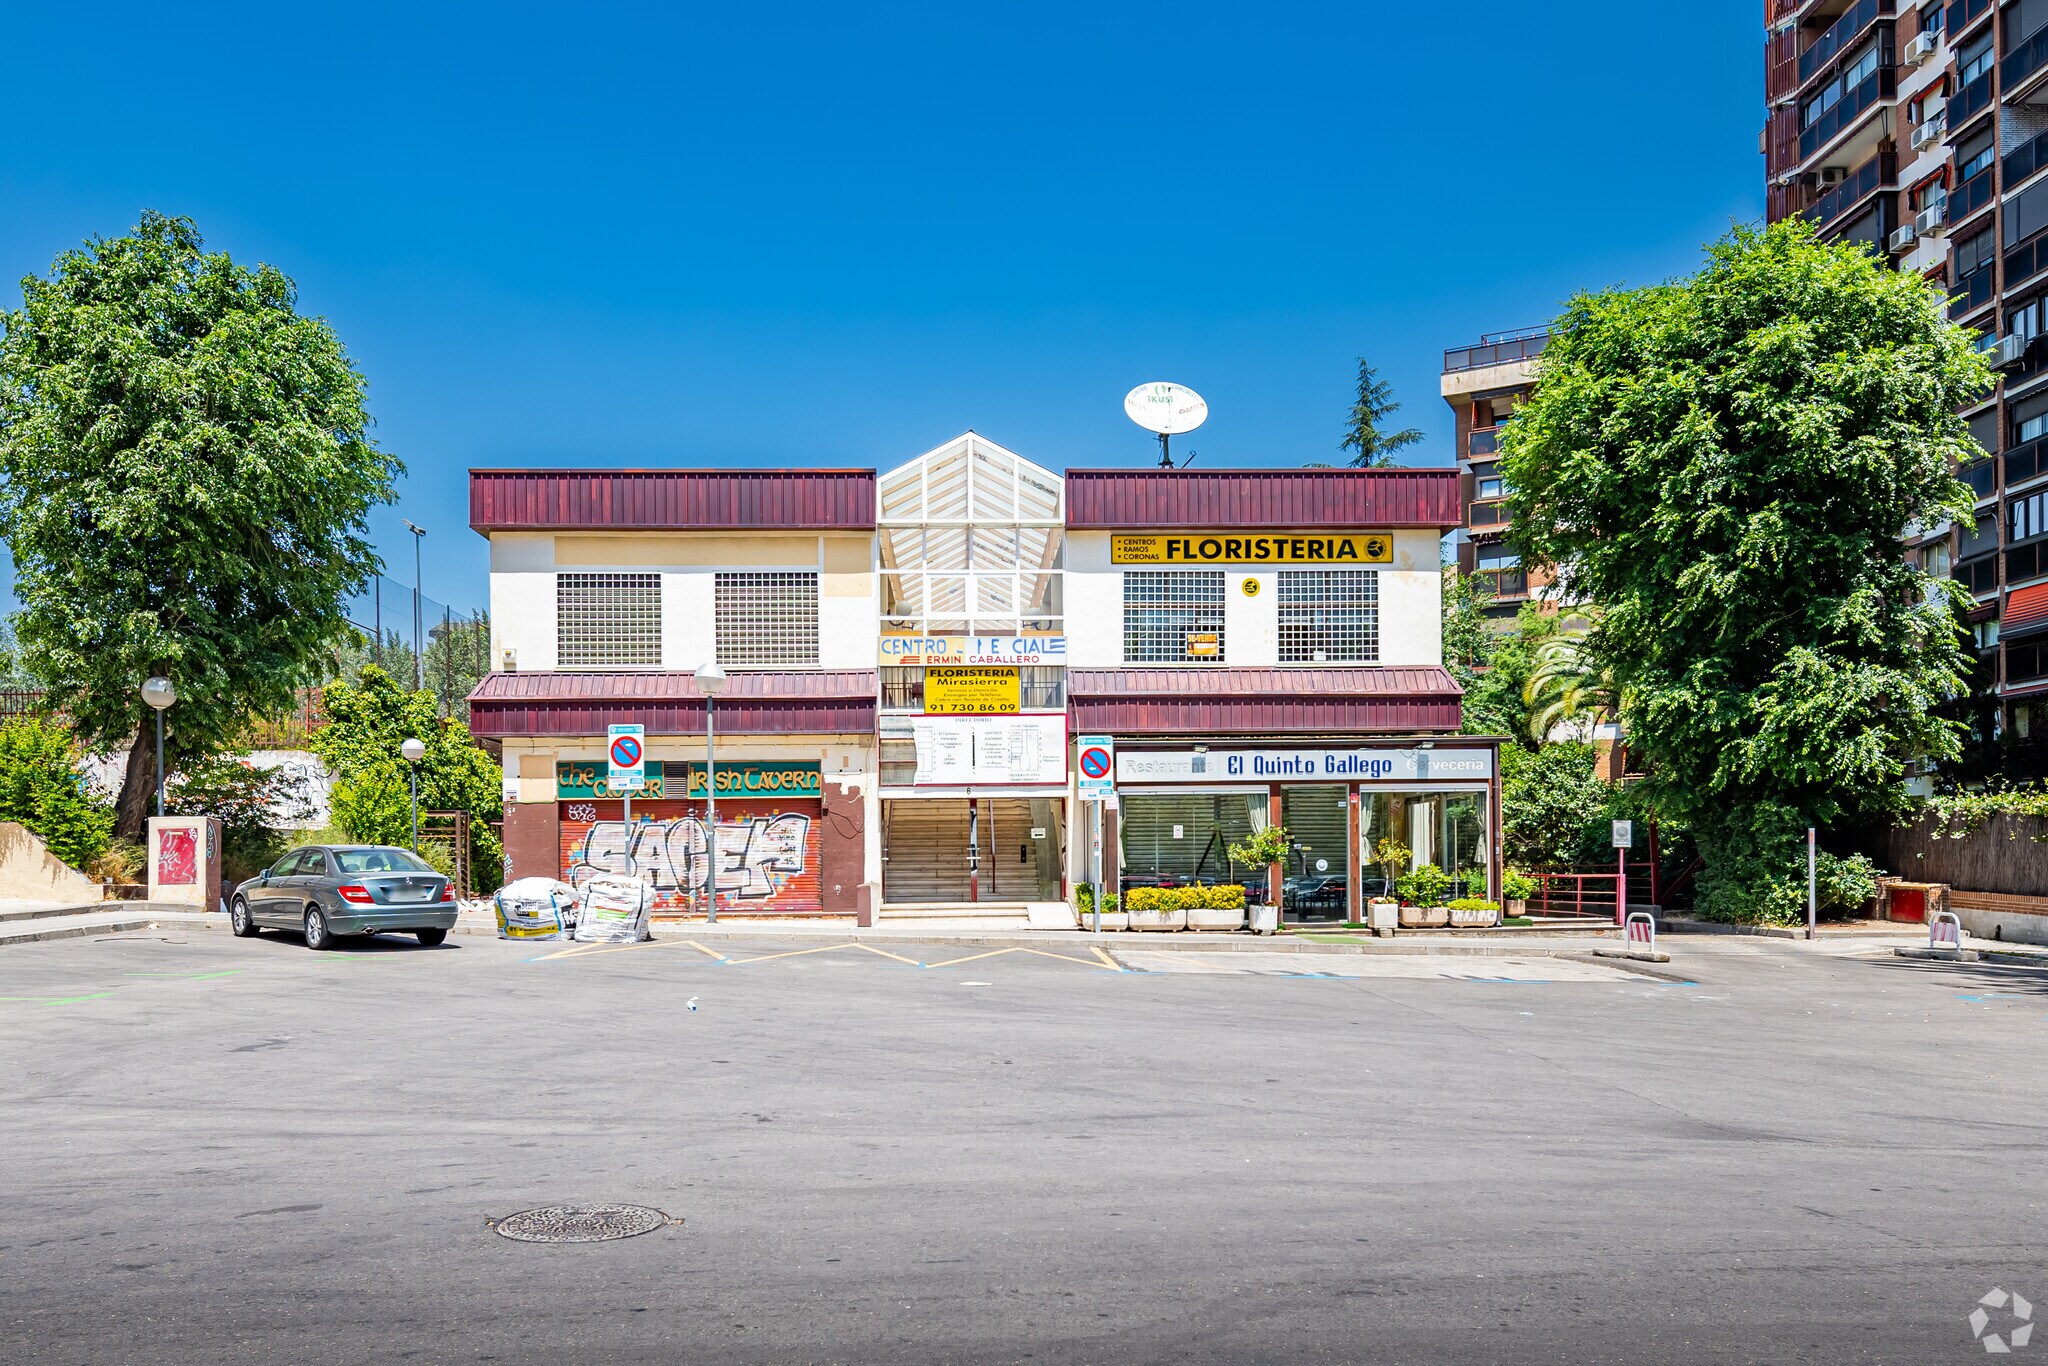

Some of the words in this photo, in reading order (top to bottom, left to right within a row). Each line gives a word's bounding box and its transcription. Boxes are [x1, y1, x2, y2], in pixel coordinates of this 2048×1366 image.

[1166, 538, 1358, 559] FLORISTERIA
[1197, 634, 1217, 643] VENDE
[881, 638, 947, 655] CENTRO
[969, 655, 1040, 664] CABALLERO
[929, 669, 1015, 677] FLORISTERIA
[936, 678, 1008, 686] Mirasierra
[929, 703, 944, 712] 91
[950, 703, 975, 712] 730
[979, 703, 995, 712] 86
[999, 703, 1016, 712] 09
[1125, 758, 1214, 774] Restaurante
[1227, 755, 1243, 774] El
[1253, 755, 1315, 776] Quinto
[1324, 754, 1392, 778] Gallego
[1406, 757, 1484, 771] Cervecería
[966, 787, 971, 795] 6
